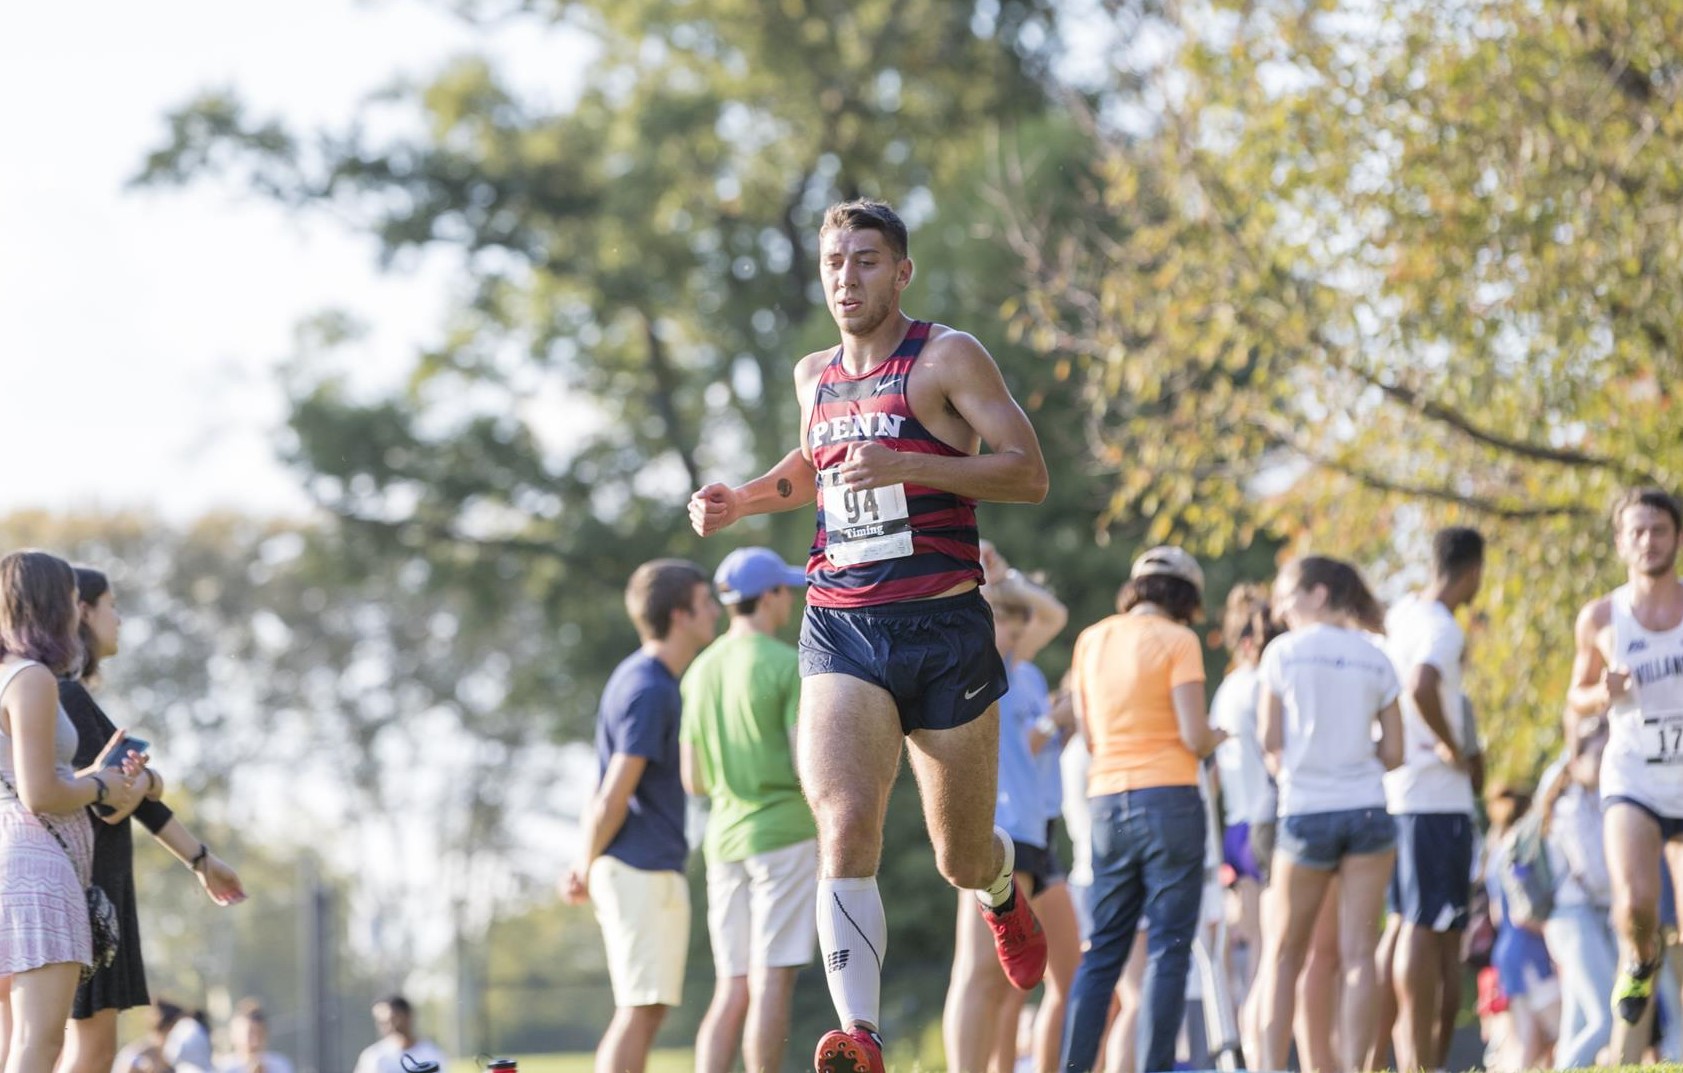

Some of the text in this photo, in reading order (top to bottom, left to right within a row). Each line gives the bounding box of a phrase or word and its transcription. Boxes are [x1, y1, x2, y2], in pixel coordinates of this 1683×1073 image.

[812, 412, 906, 448] PENN
[843, 487, 880, 523] 94
[846, 525, 885, 539] Timing
